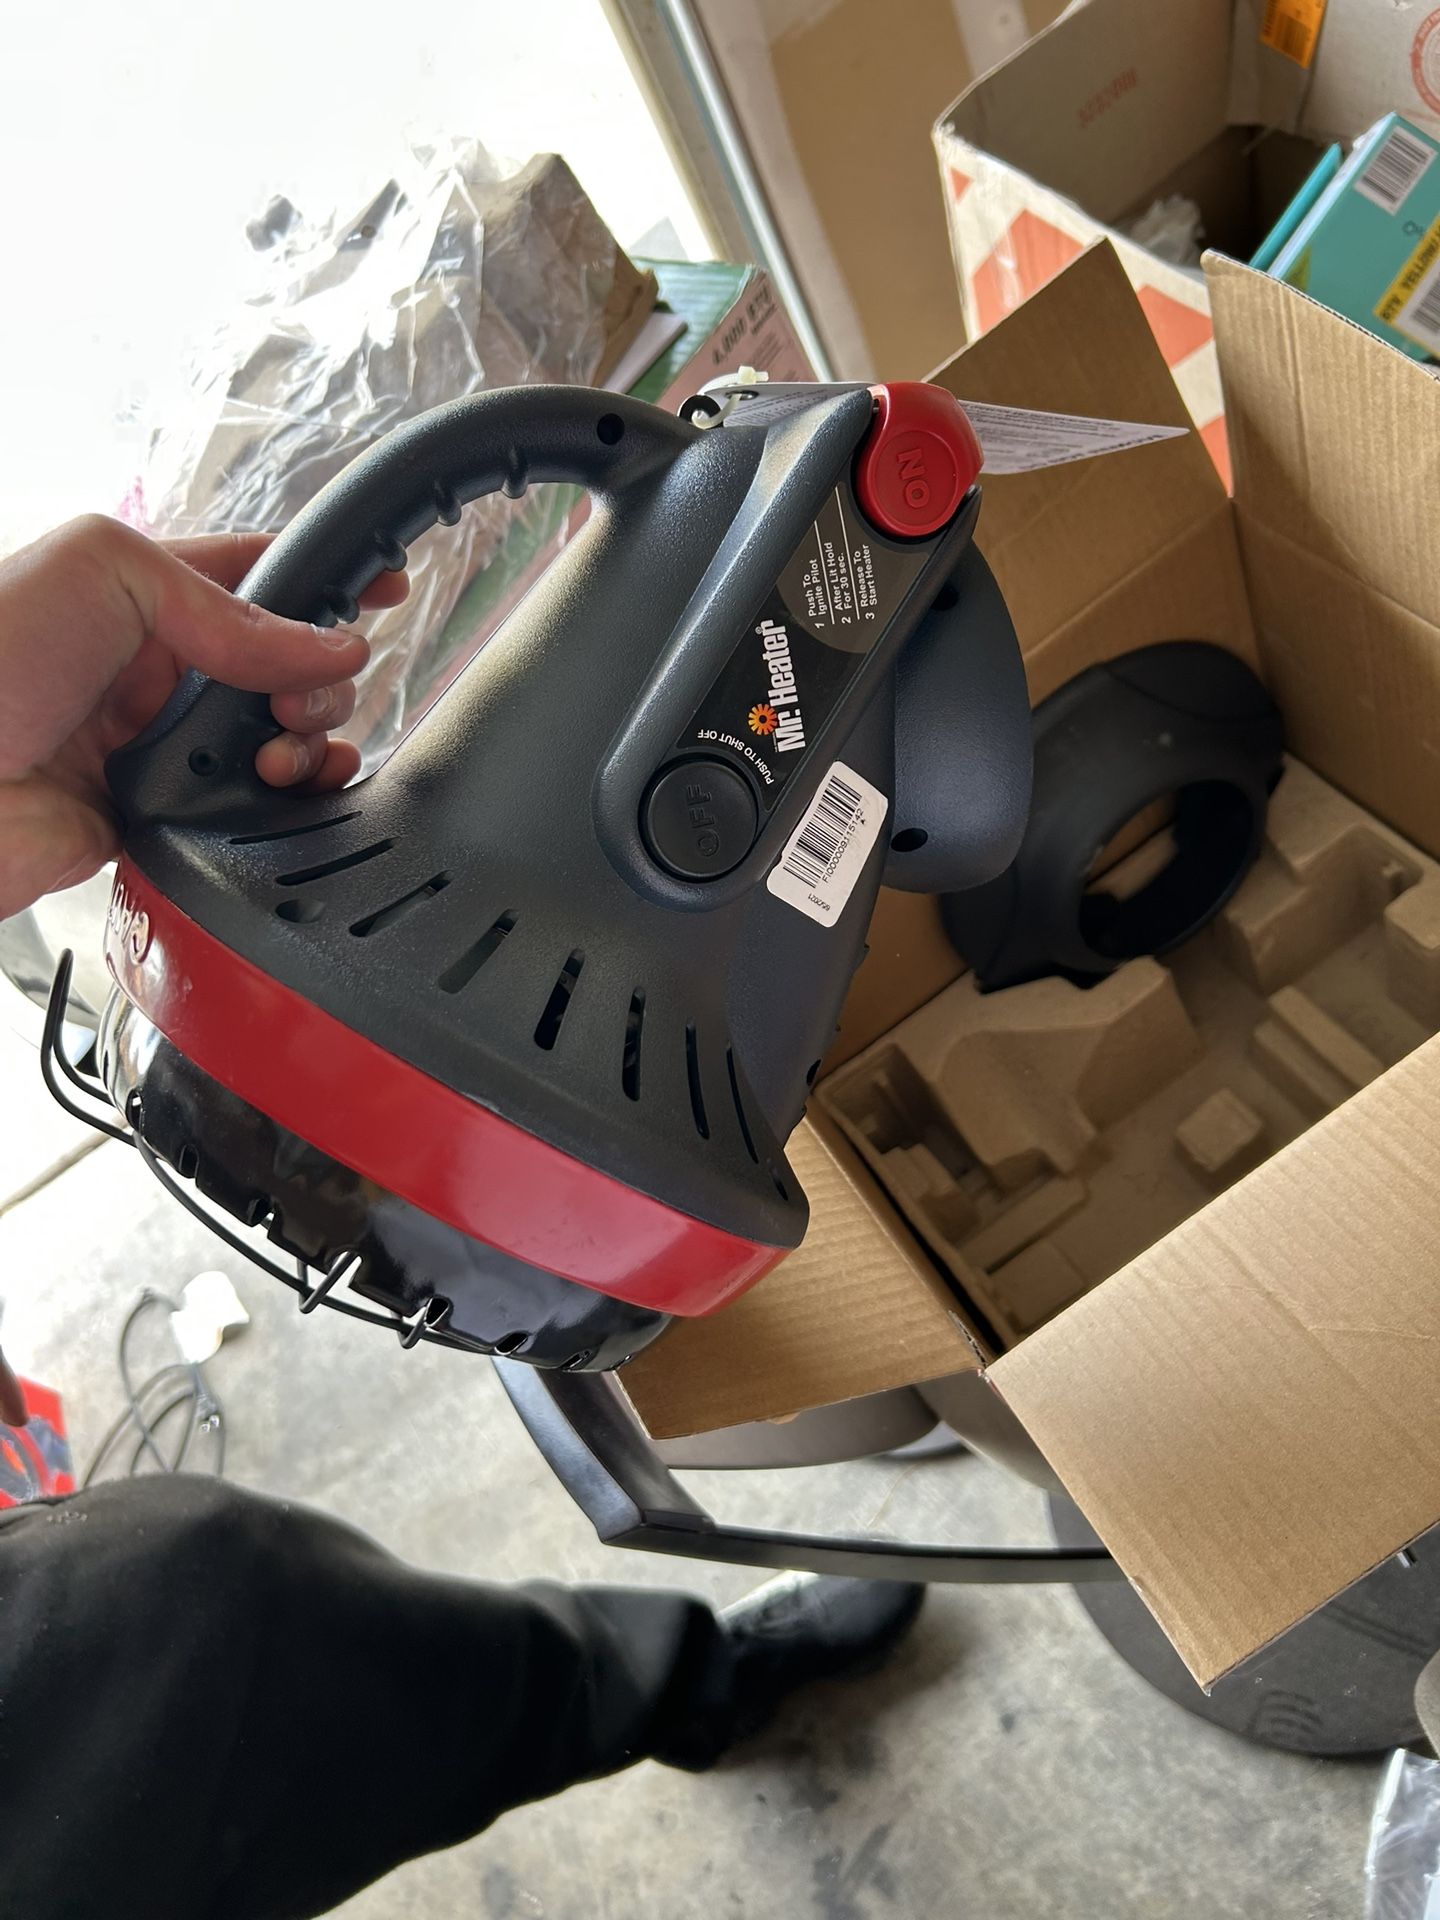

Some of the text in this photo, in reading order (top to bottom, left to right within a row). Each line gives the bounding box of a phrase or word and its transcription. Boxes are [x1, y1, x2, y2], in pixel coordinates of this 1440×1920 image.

[896, 448, 930, 509] ON
[802, 574, 817, 617] Push To
[809, 558, 821, 584] Pilot
[815, 585, 828, 616] Ignite
[823, 542, 844, 611] After Lit Hold
[837, 552, 852, 624] 2 For 30 sec.
[853, 551, 869, 608] Release To
[862, 544, 878, 620] 3 Start Heater
[760, 619, 806, 753] Mr. Heater
[697, 729, 775, 785] PUSH TO SHUT OFF
[686, 784, 721, 857] OFF
